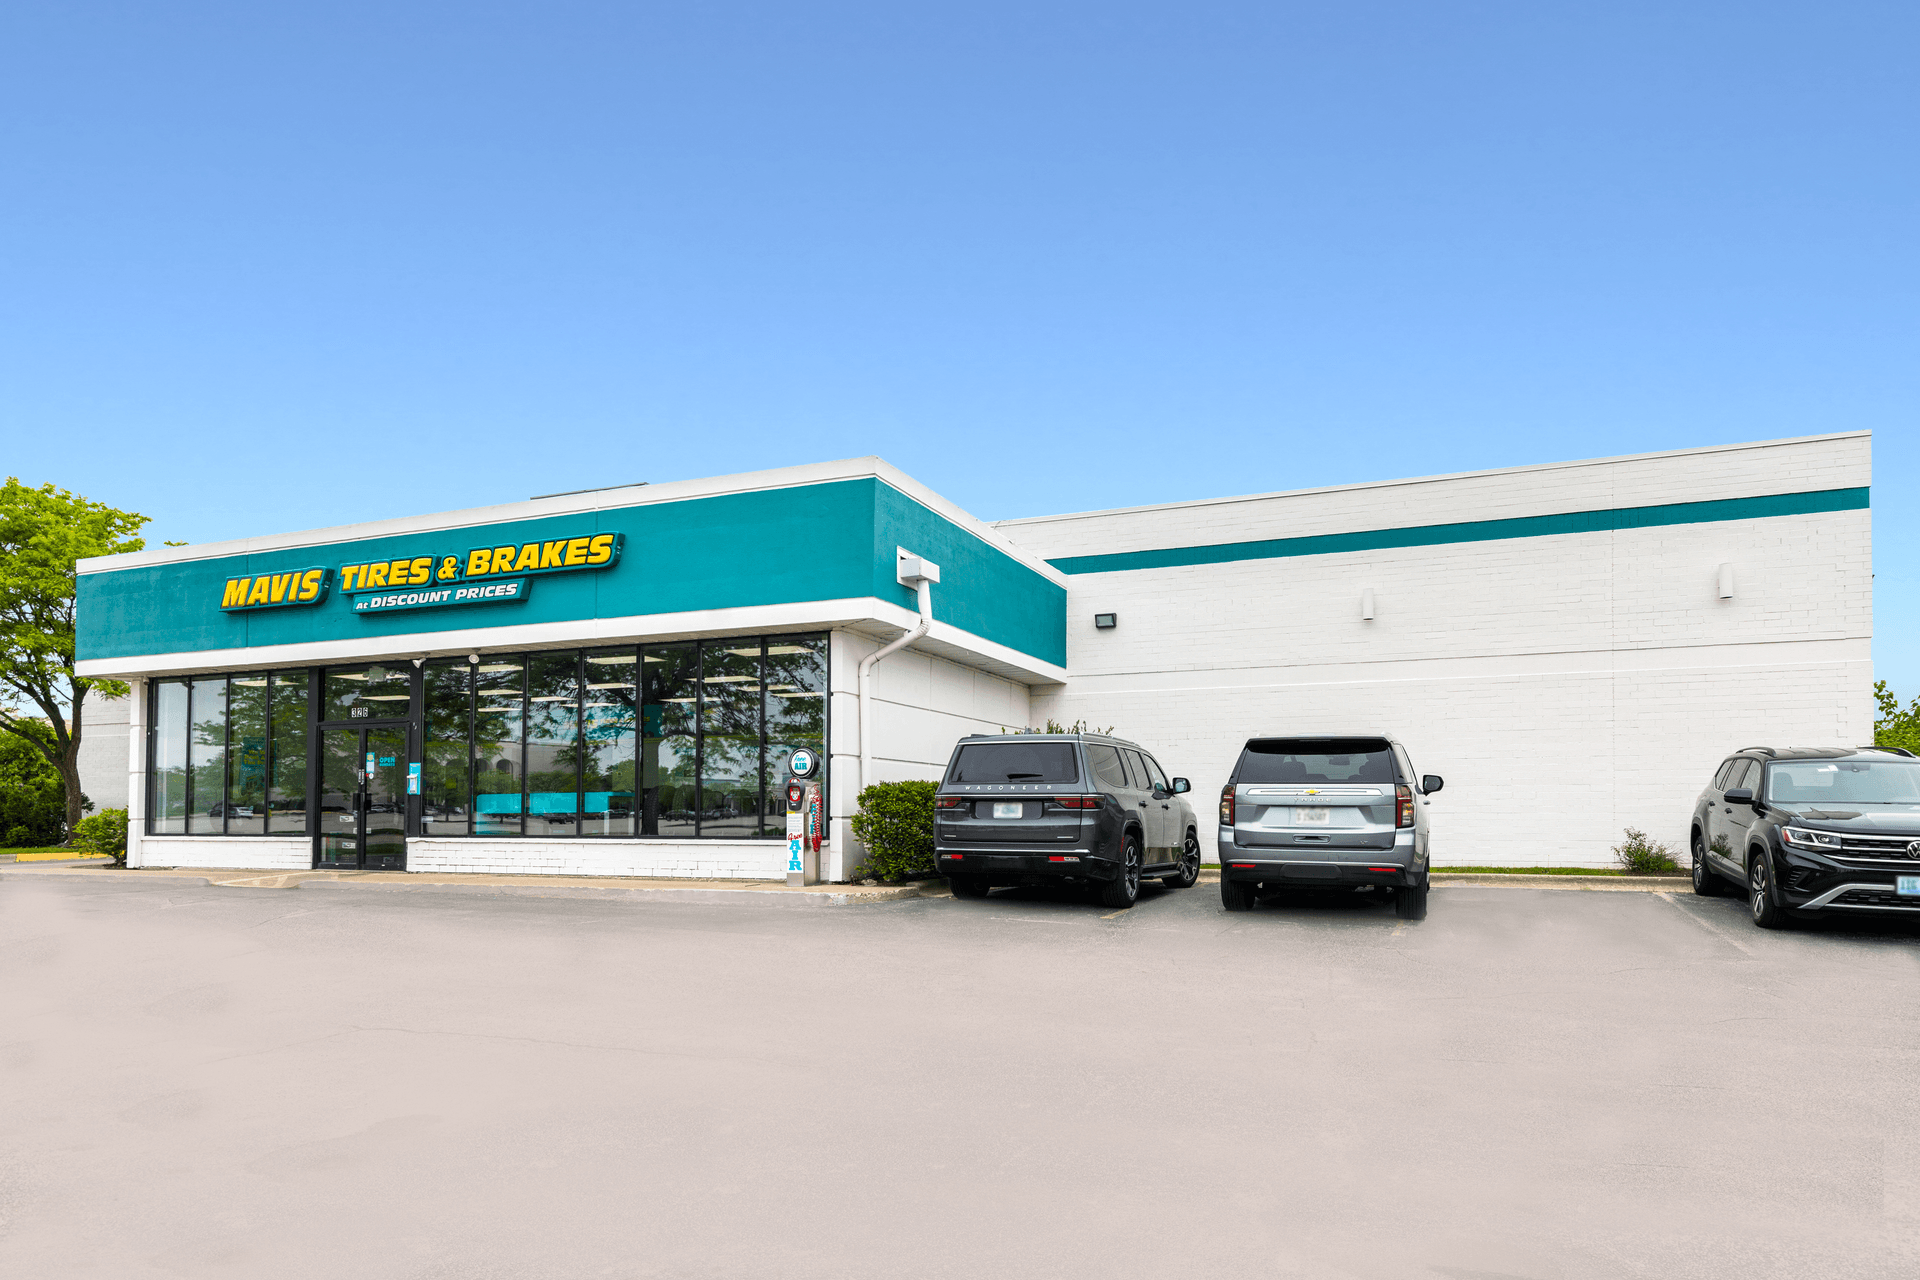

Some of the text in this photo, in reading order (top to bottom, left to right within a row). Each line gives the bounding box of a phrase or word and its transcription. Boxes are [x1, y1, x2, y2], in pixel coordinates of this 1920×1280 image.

[221, 534, 614, 608] MAVIS TIRES & BRAKES
[370, 590, 452, 608] DISCOUNT
[455, 583, 518, 601] PRICES
[351, 707, 369, 718] 326
[789, 840, 802, 870] AIR
